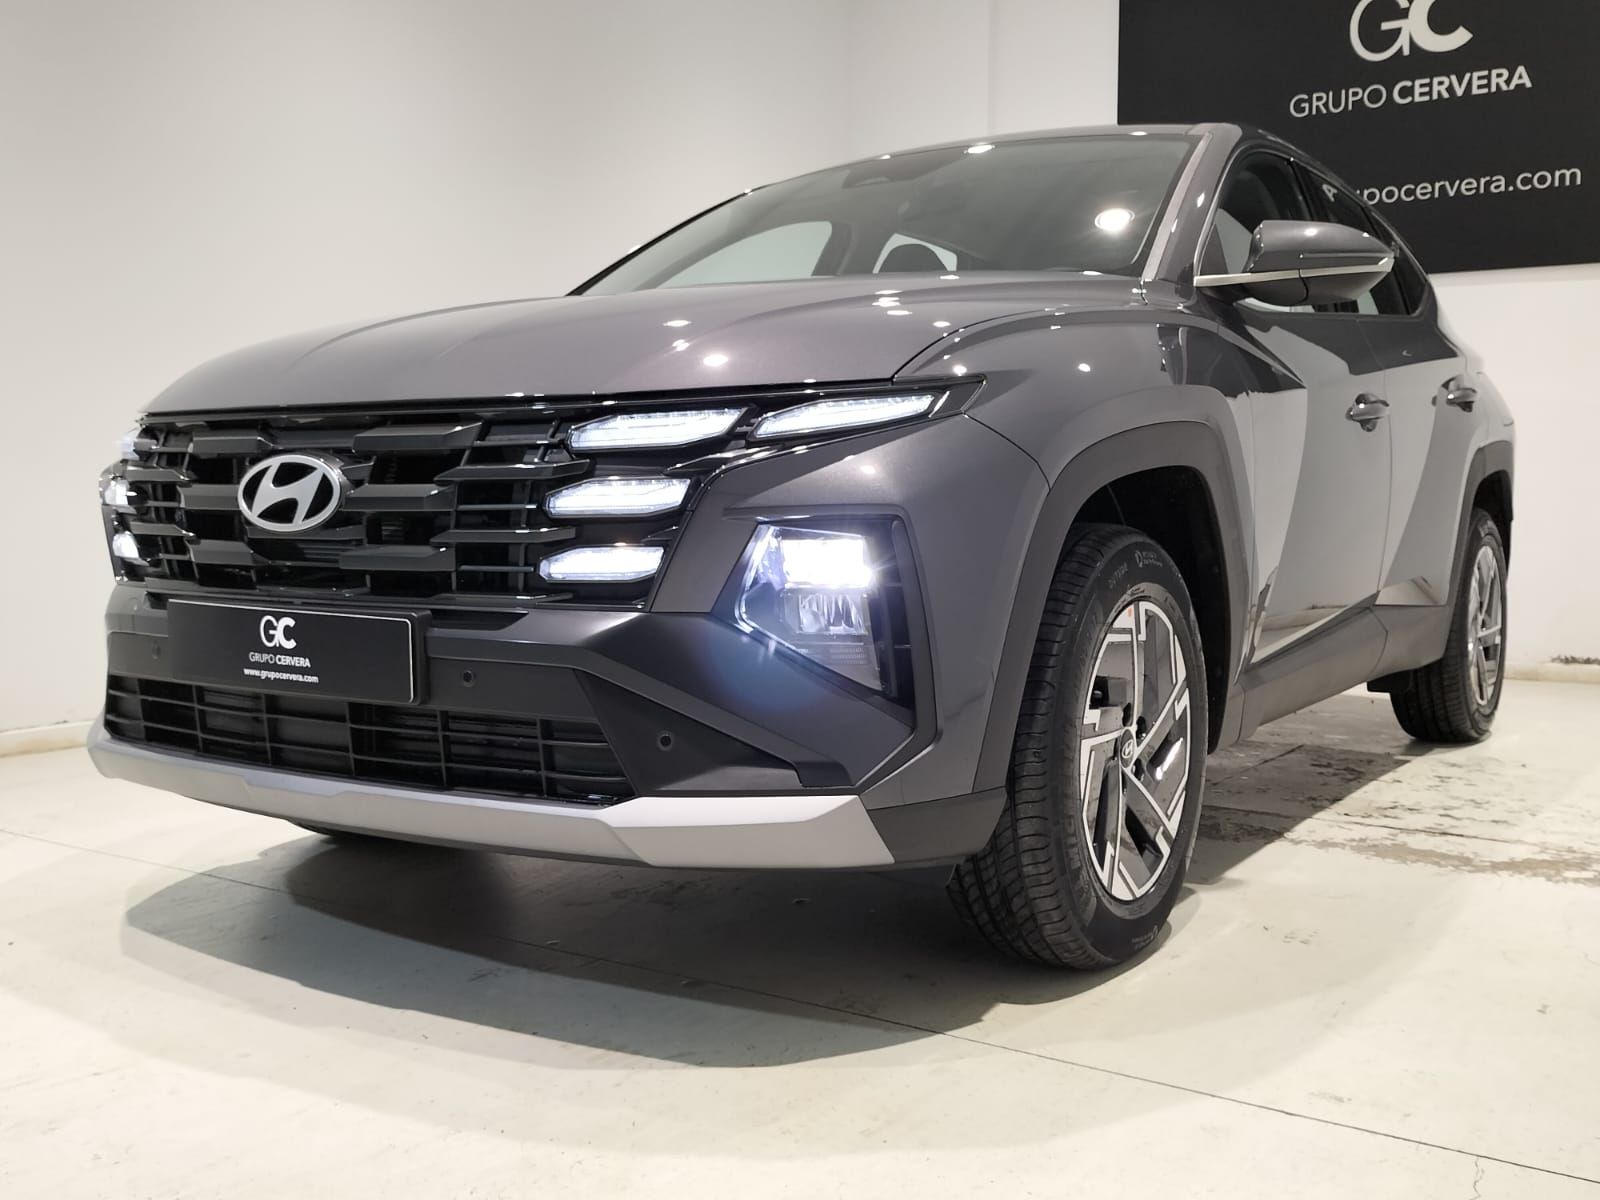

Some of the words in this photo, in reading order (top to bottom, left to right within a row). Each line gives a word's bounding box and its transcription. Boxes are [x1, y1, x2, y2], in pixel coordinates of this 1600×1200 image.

[1289, 84, 1387, 118] GRUPO
[1392, 65, 1533, 105] CERVERA
[1355, 167, 1582, 206] pocervera.com
[260, 615, 297, 649] GC
[243, 668, 319, 683] www.grupocervera.com
[249, 652, 275, 664] GRUPO
[275, 654, 311, 668] CERVERA
